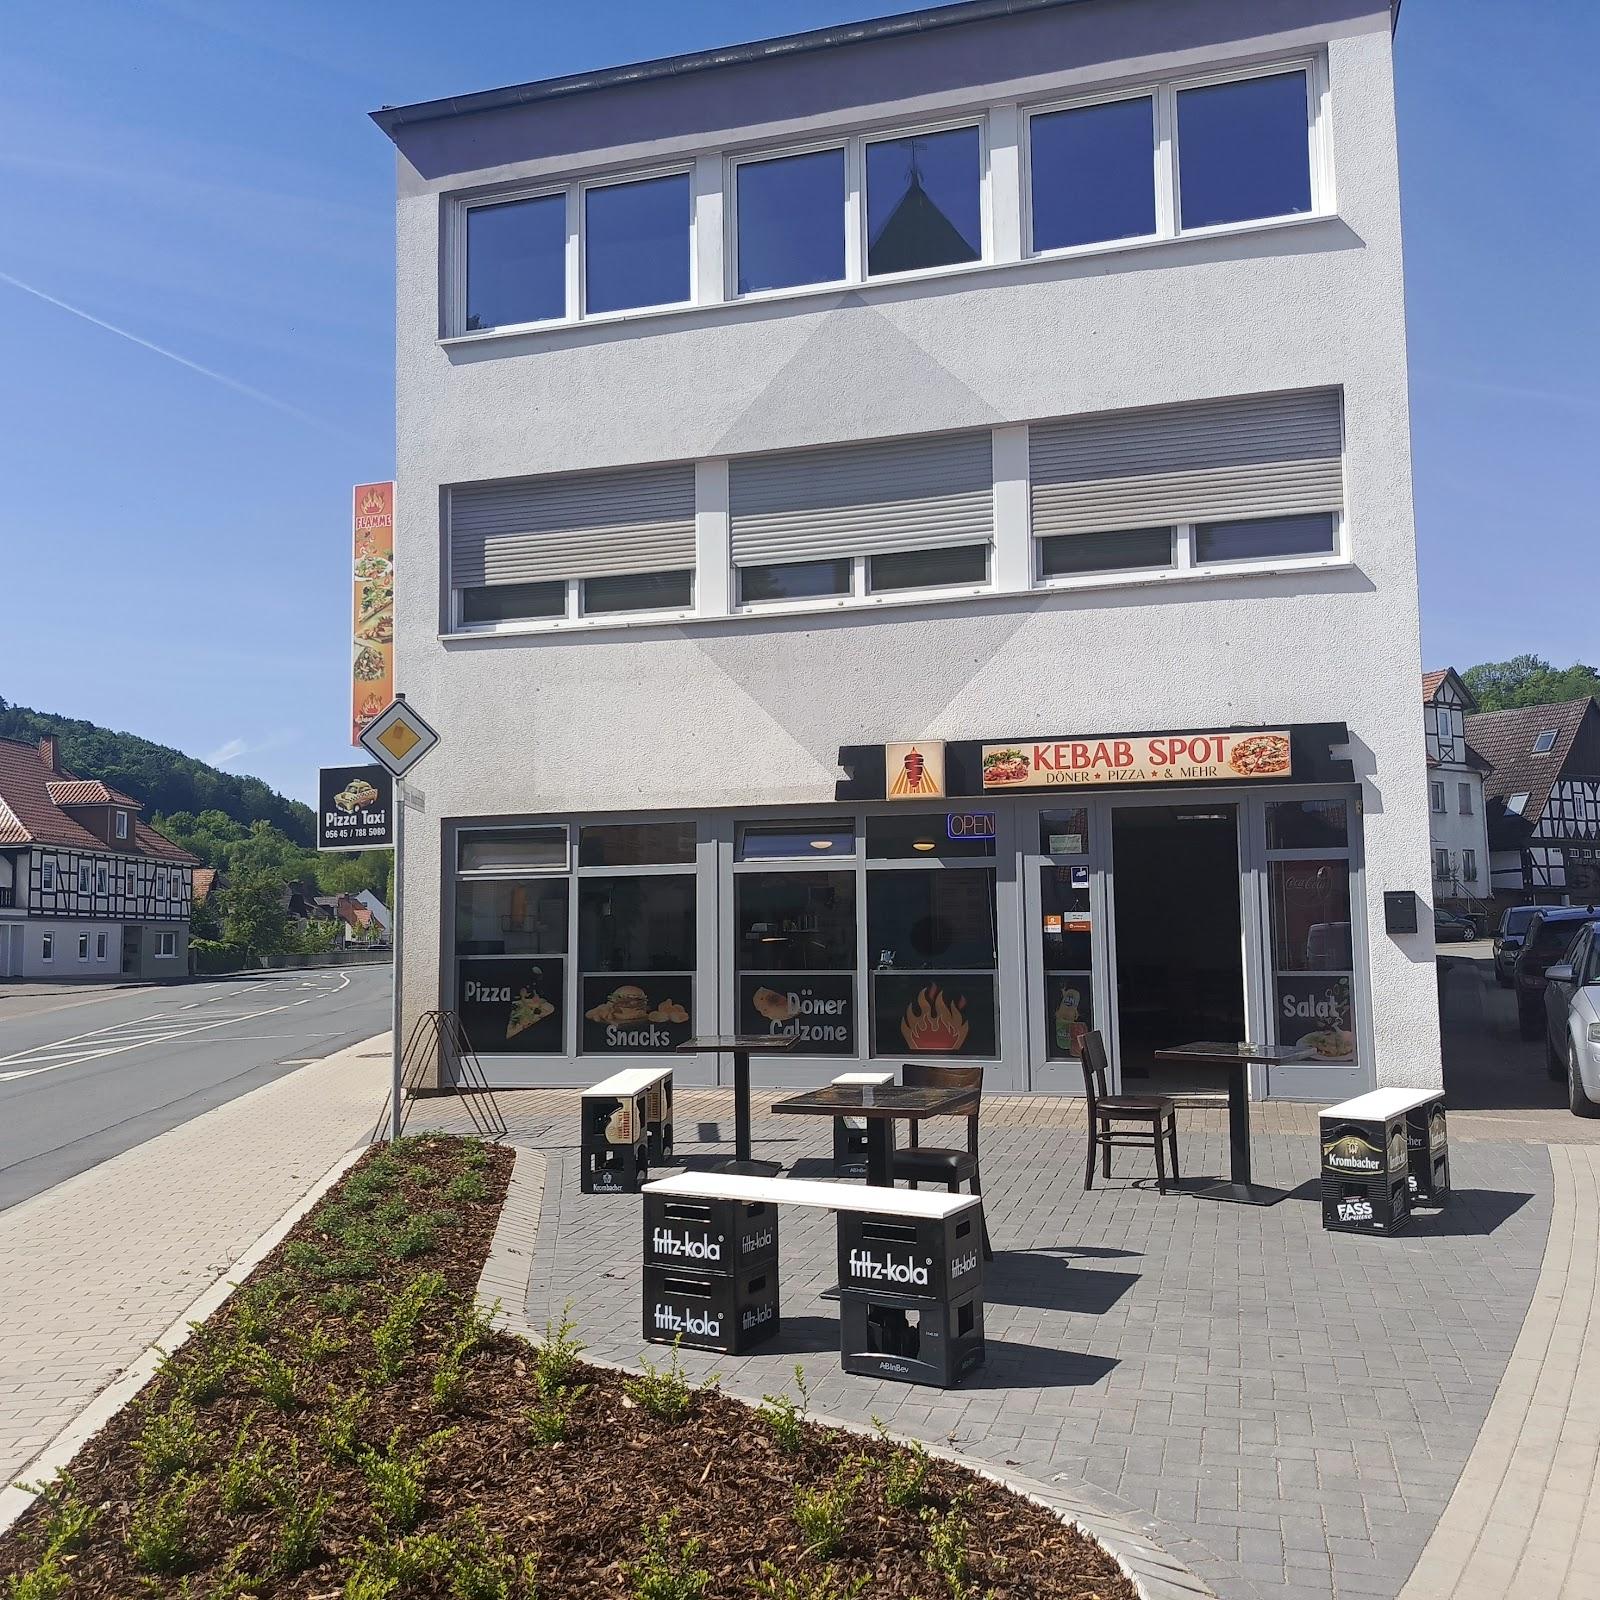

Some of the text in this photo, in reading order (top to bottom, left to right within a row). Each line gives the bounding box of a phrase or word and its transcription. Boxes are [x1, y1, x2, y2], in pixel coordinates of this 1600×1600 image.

[356, 514, 392, 529] FLAMME
[1033, 736, 1230, 771] KEBAB SPOT
[1047, 766, 1217, 784] DÖNER PIZZA & MEHR
[325, 809, 386, 827] Pizza Taxi
[950, 815, 995, 836] OPEN
[325, 830, 339, 839] 056
[340, 829, 348, 838] 45
[355, 828, 367, 837] 788
[464, 980, 511, 1002] Pizza
[787, 989, 847, 1015] Döner
[1282, 995, 1341, 1018] Salat
[606, 1024, 670, 1048] Snacks
[769, 1019, 847, 1041] Calzone
[1329, 1153, 1380, 1170] Krombacher
[1337, 1202, 1373, 1216] FASS
[879, 1361, 909, 1374] ABInBev
